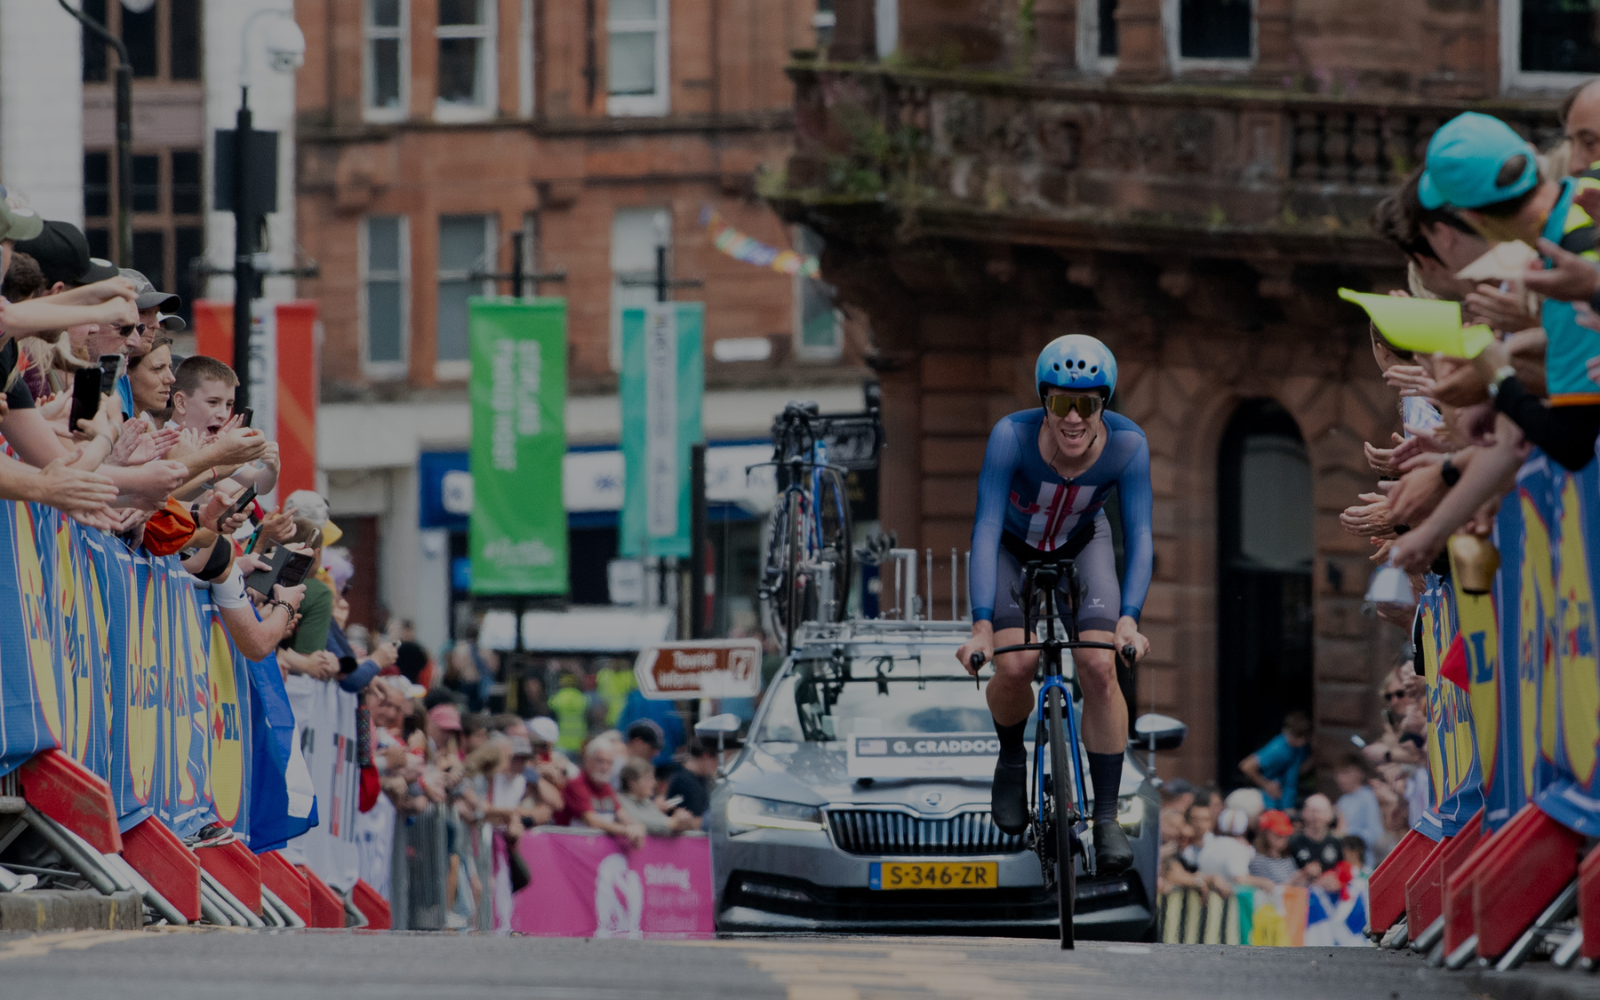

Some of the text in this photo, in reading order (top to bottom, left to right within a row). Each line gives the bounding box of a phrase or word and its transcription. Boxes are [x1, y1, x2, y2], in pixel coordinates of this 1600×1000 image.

[672, 650, 717, 670] Tourist
[893, 739, 1001, 754] G. CRADDOC
[891, 866, 987, 885] S-346-ZR
